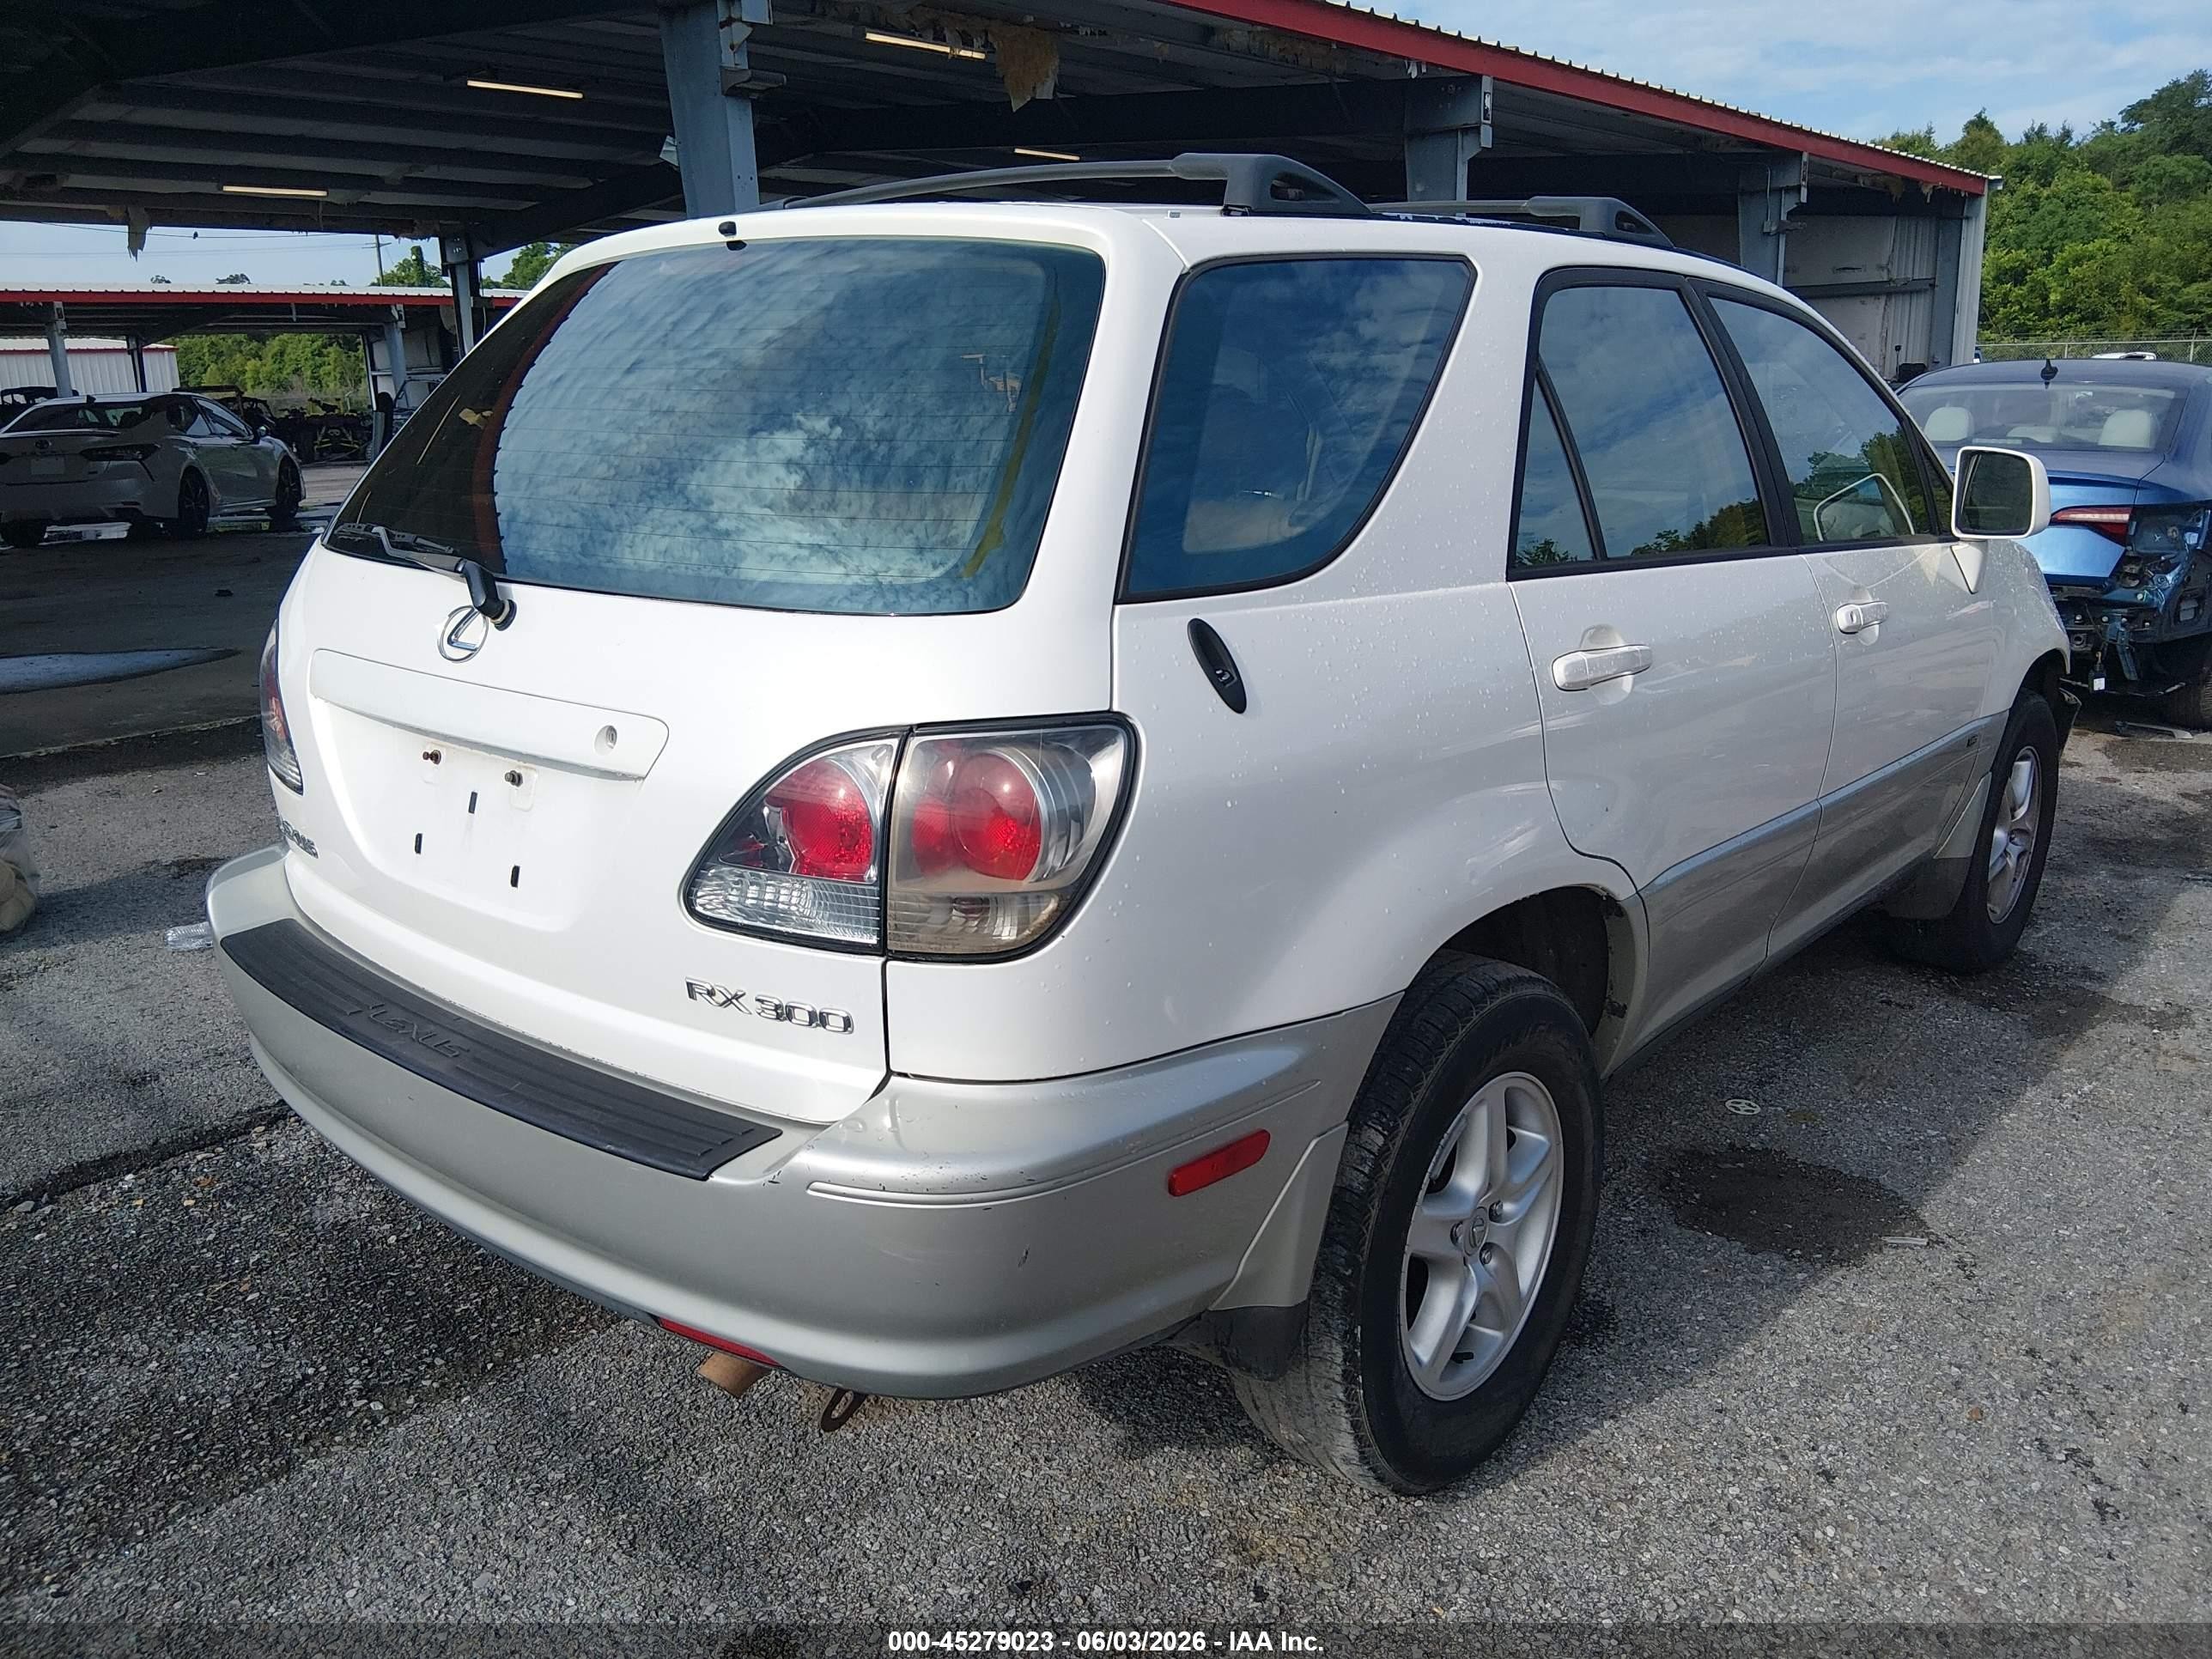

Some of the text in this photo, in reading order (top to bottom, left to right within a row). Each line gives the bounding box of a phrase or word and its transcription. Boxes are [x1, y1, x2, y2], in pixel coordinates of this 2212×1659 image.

[685, 976, 854, 1035] RX 300
[369, 1009, 471, 1058] LEXUS
